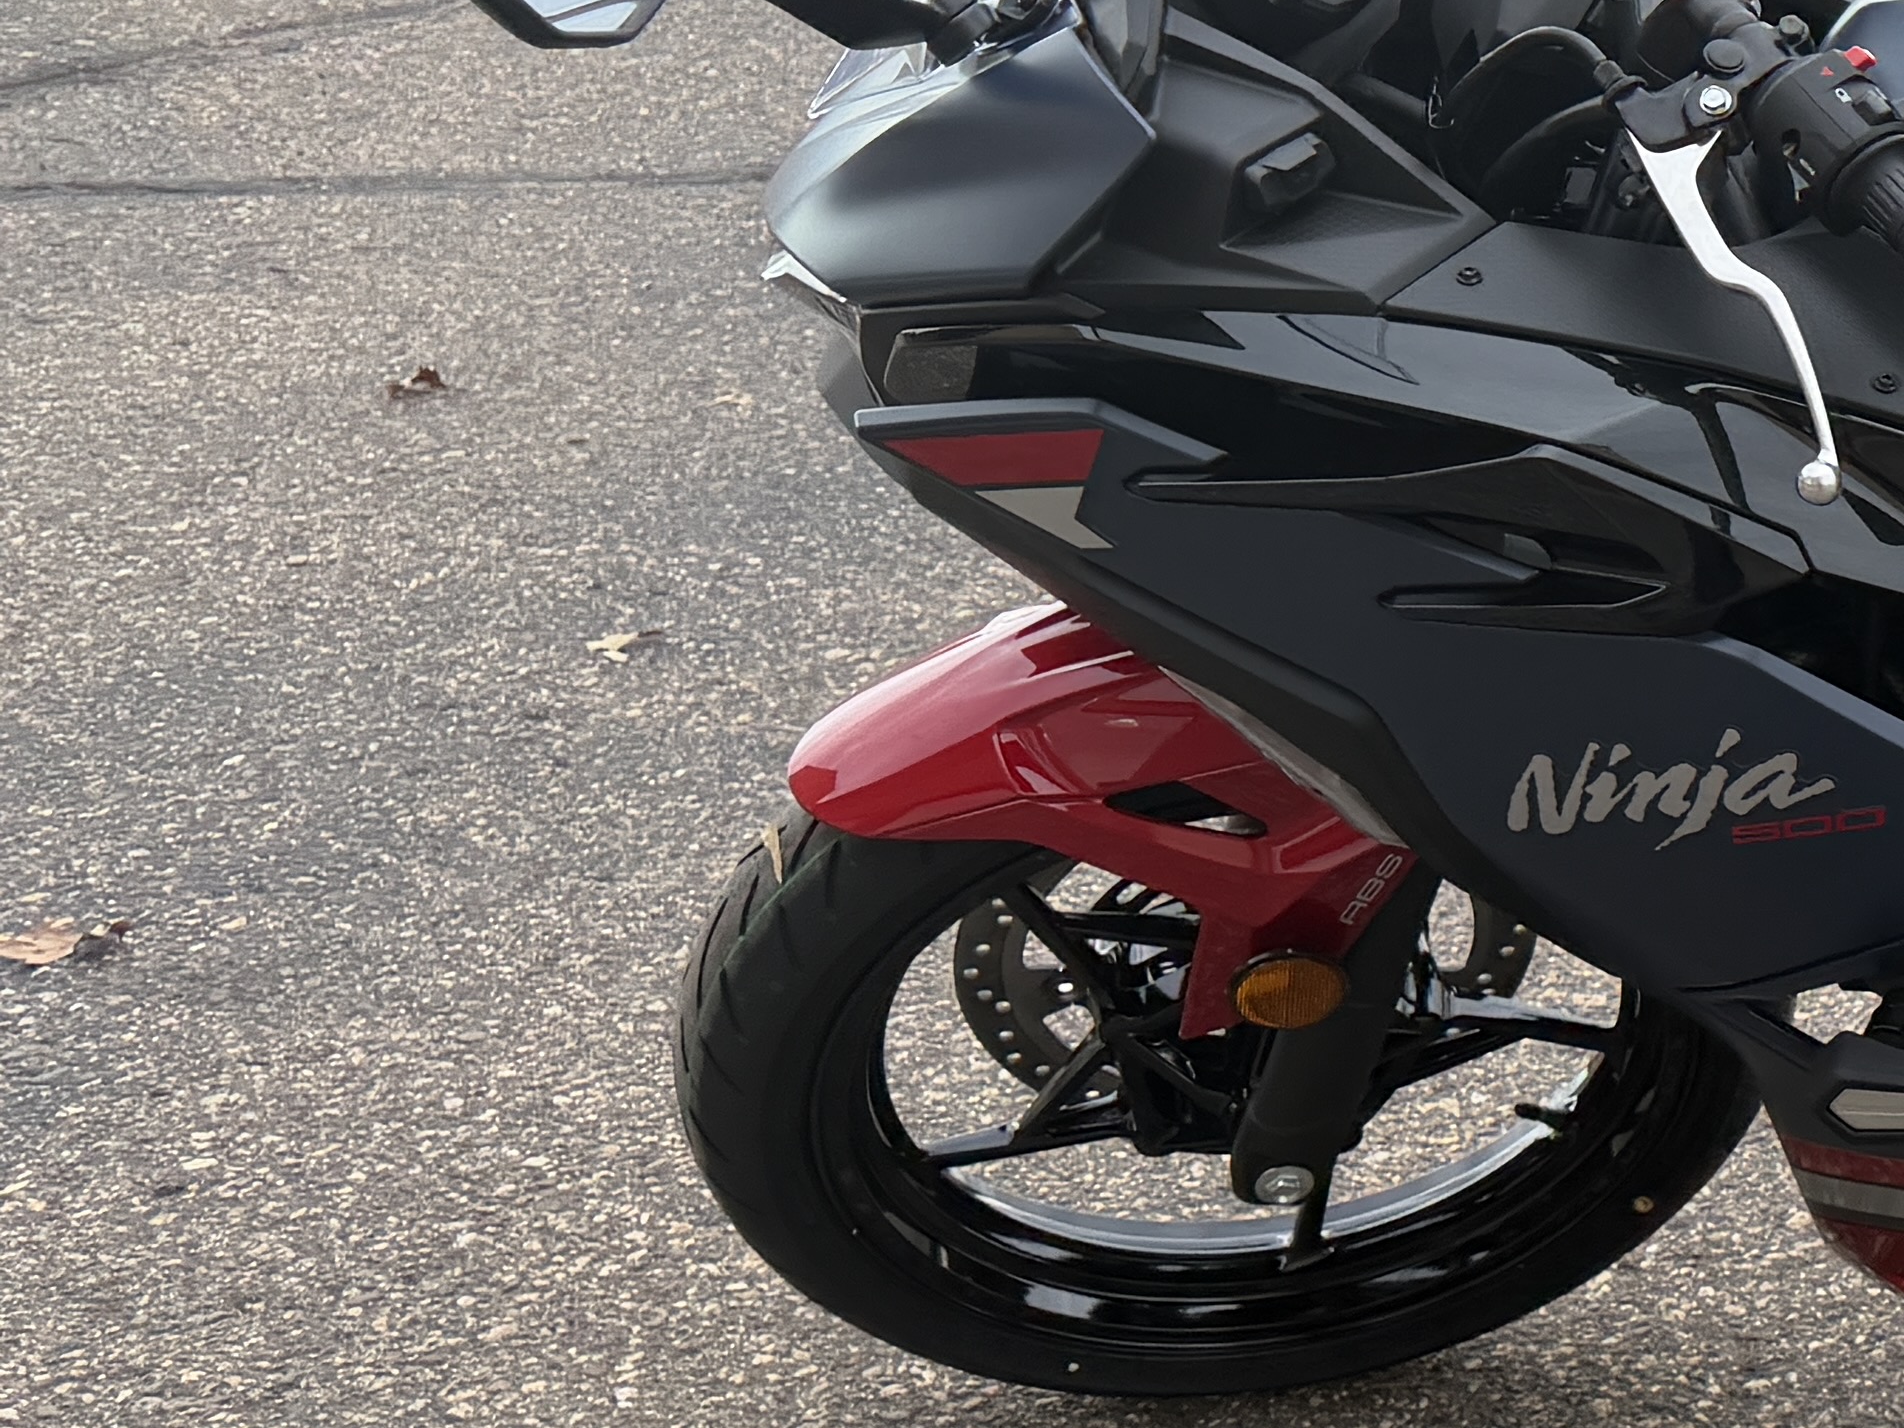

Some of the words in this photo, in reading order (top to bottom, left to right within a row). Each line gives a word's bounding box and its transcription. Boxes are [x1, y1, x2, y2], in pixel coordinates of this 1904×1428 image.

[1507, 728, 1836, 851] Ninja
[1731, 806, 1887, 844] 500
[1339, 853, 1403, 925] ABS
